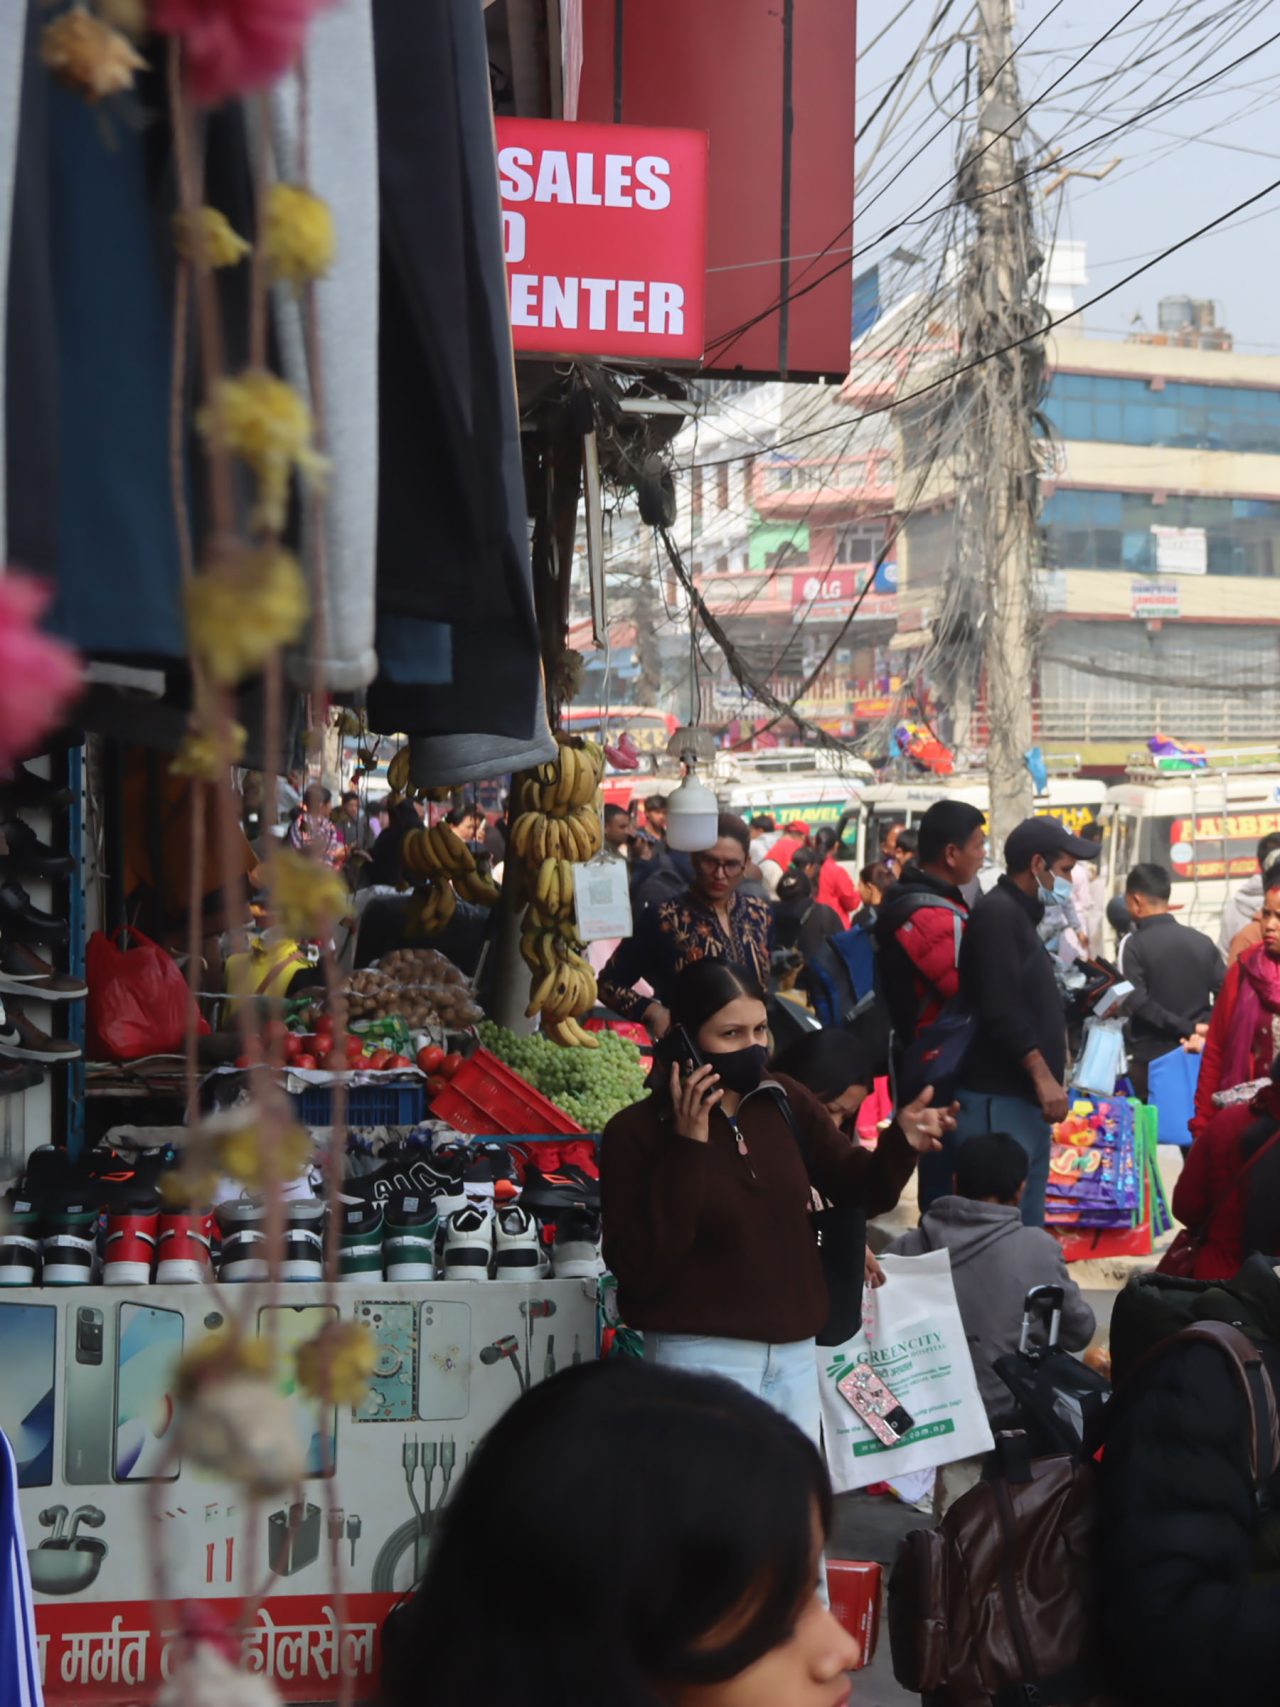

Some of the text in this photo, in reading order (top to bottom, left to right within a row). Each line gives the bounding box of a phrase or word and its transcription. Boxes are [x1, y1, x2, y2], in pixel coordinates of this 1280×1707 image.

[497, 147, 671, 211] SALES
[510, 273, 684, 336] ENTER
[821, 580, 841, 599] LG
[60, 1615, 150, 1686] मर्मत
